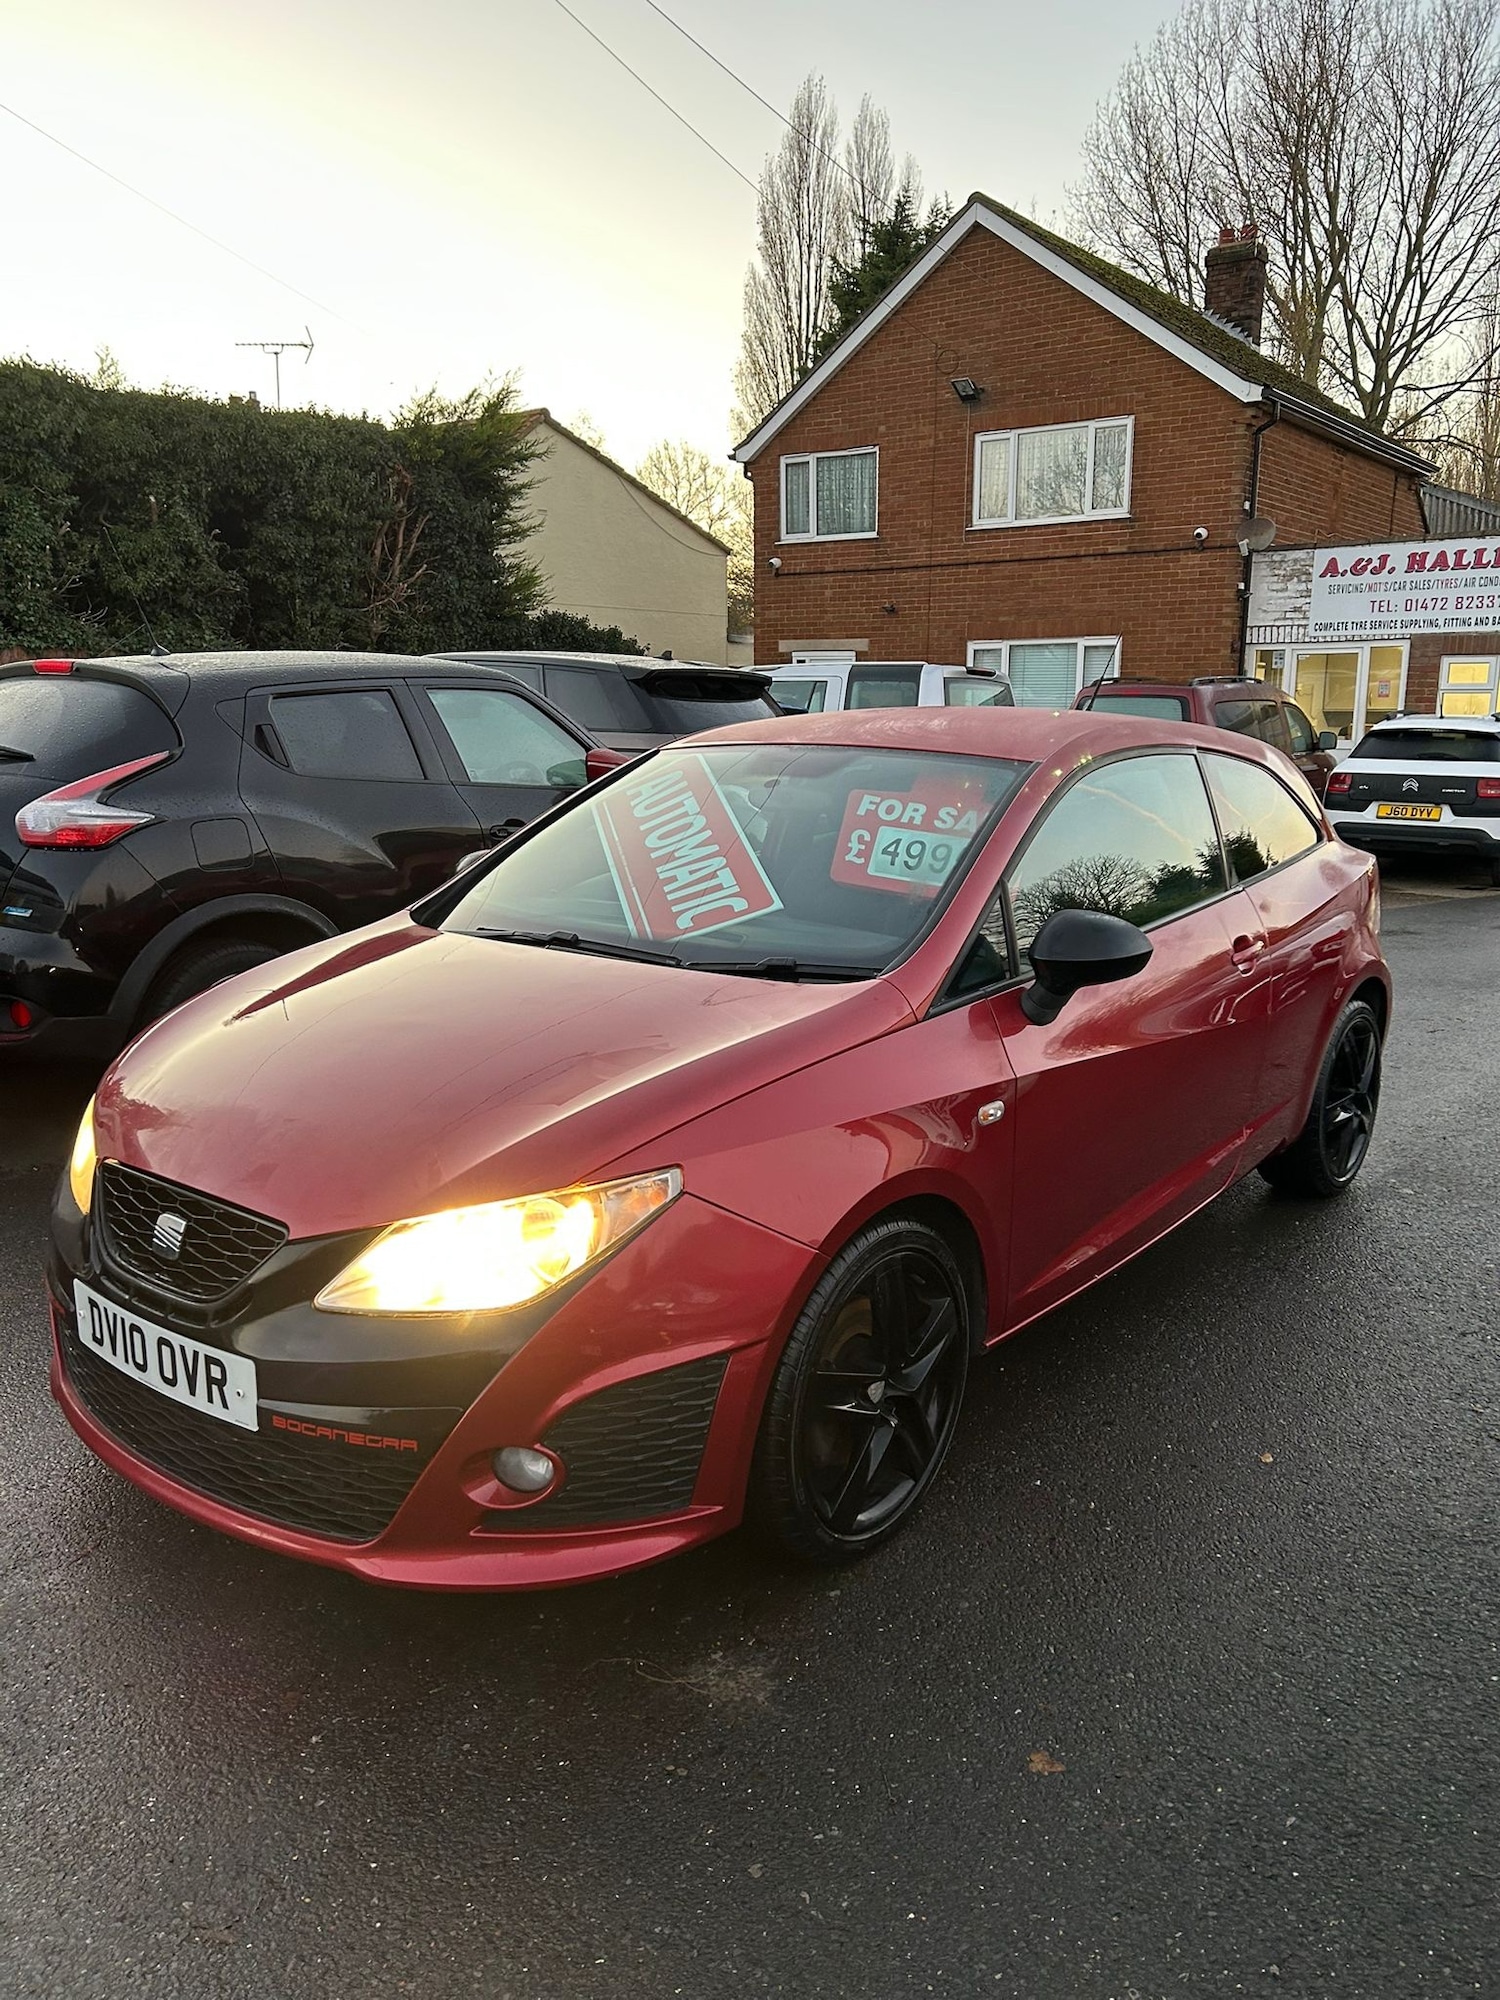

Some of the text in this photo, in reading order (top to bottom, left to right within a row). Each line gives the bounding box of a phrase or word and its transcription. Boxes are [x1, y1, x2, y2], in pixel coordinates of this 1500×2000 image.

[1370, 594, 1500, 613] TEL: 01472 8233
[1314, 621, 1349, 632] COMPLETE
[1351, 620, 1367, 631] TYRE
[1369, 619, 1398, 630] SERVICE
[1400, 617, 1441, 630] SUPPLYING,
[1443, 616, 1472, 628] FITTING
[1474, 616, 1489, 627] AND
[857, 794, 988, 833] FOR SA
[1386, 806, 1433, 818] J60 DYV
[626, 770, 748, 929] AUTOMATIC
[88, 1296, 229, 1411] DV10 OVR
[272, 1415, 418, 1452] BOCANEGRA
